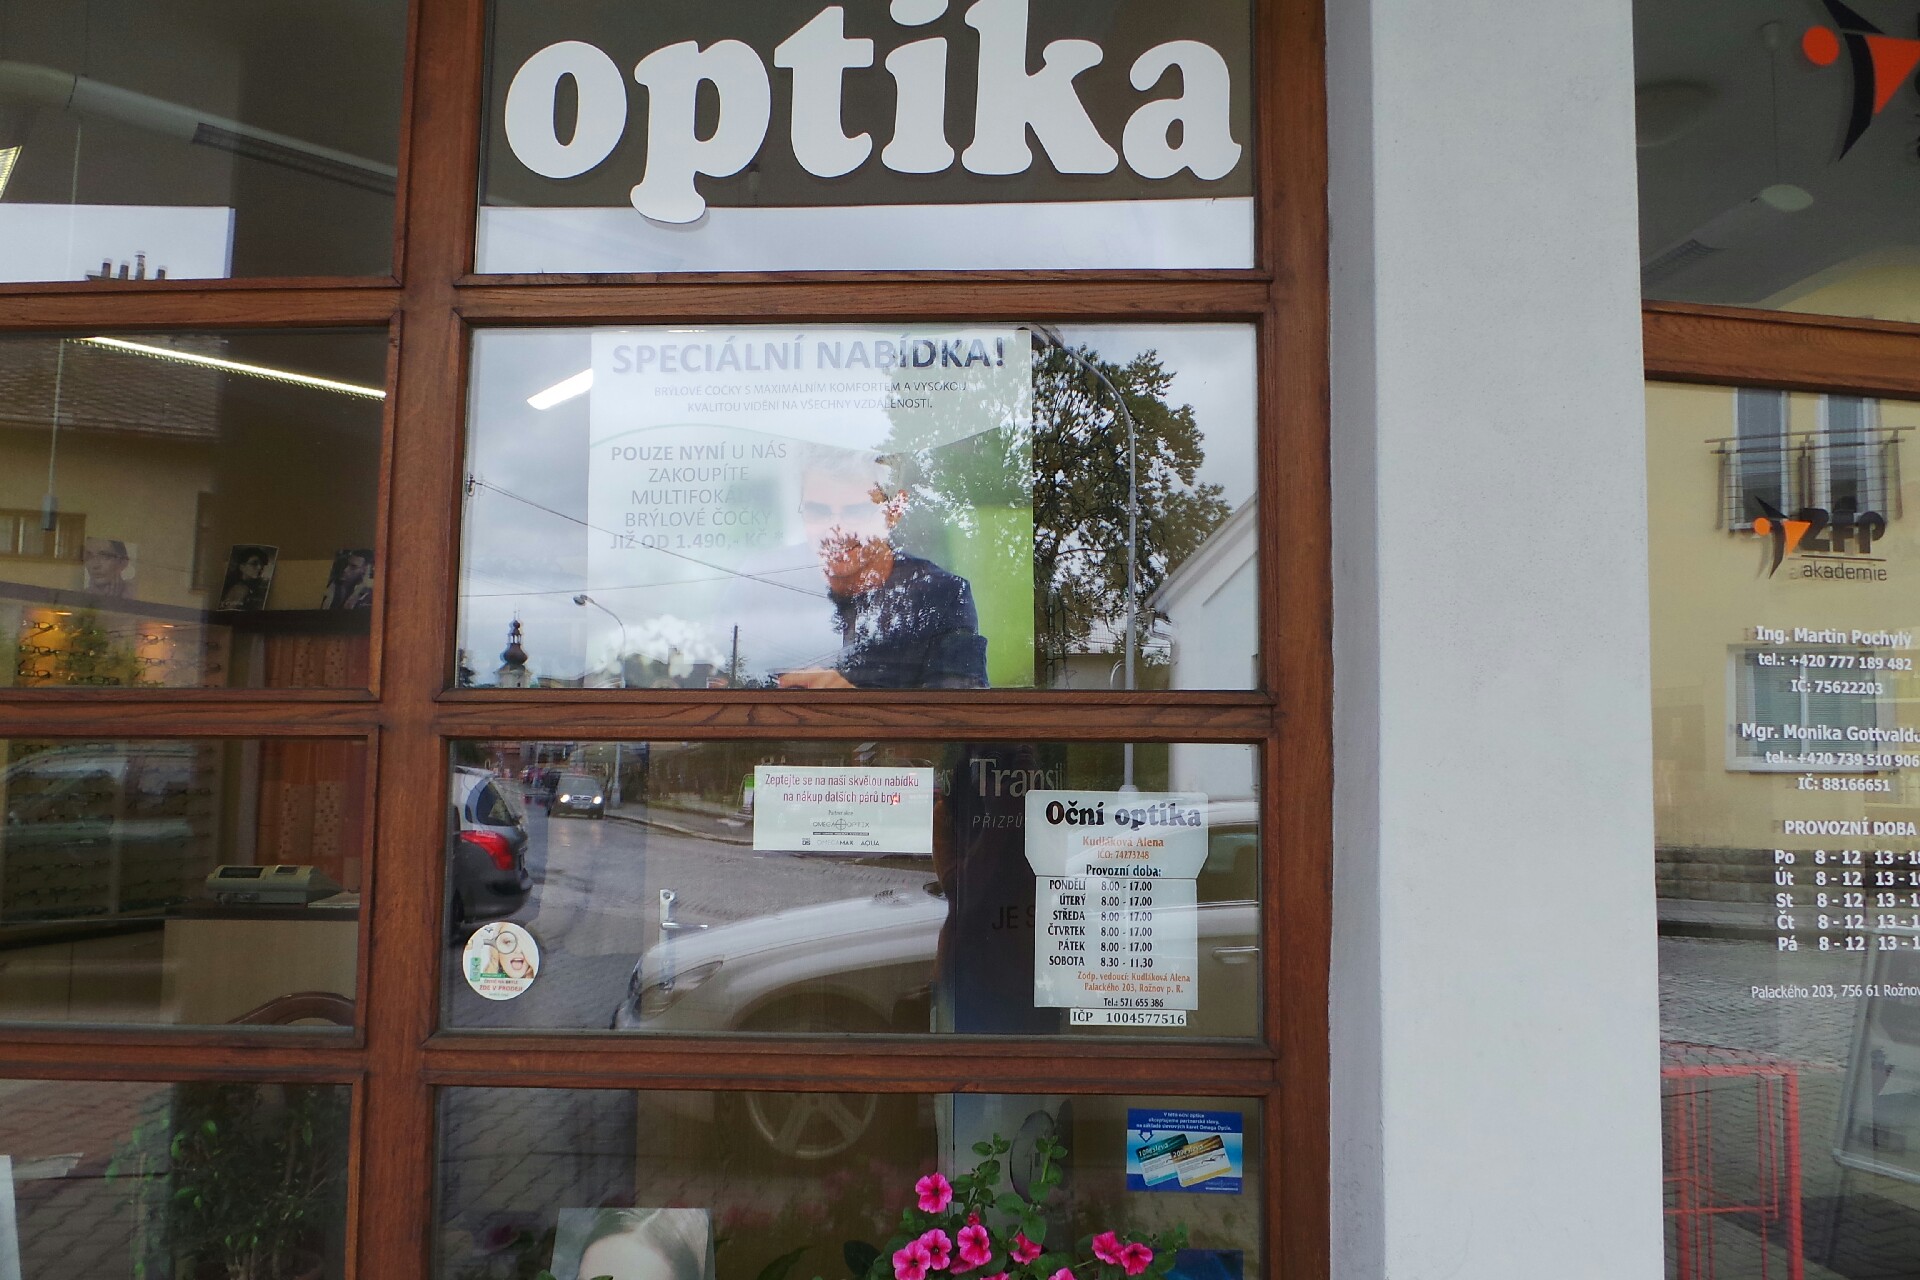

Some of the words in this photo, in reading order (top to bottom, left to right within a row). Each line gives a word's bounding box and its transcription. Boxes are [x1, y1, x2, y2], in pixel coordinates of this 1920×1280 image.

[505, 0, 1242, 223] optika
[612, 336, 804, 374] SPECIÁLNÍ
[817, 334, 1005, 370] NABÍDKA!
[745, 386, 751, 395] S
[830, 382, 900, 393] KOMFORTEM
[904, 382, 911, 391] A
[687, 402, 741, 413] KVALITOU
[782, 401, 798, 411] NA
[800, 397, 851, 410] VŠECHNY
[611, 446, 673, 461] POUZE
[679, 441, 726, 461] NYNÍ
[733, 445, 744, 460] U
[752, 440, 787, 459] NÁS
[648, 463, 749, 483] ZAKOUPÍTE
[625, 508, 705, 528] BRÝLOVÉ
[712, 507, 772, 526] ČOČKY
[610, 530, 636, 549] JIŽ
[642, 534, 670, 549] OD
[1803, 562, 1887, 581] akademie
[1757, 626, 1789, 645] Ing.
[1794, 627, 1846, 644] Martin
[1852, 629, 1911, 649] Pochylý
[1758, 653, 1785, 666] tel.:
[1790, 655, 1825, 668] +420
[1829, 656, 1854, 669] 777
[1859, 656, 1883, 669] 189
[1887, 657, 1911, 670] 482
[1791, 676, 1811, 693] IČ:
[1815, 680, 1883, 695] 75622203
[1742, 723, 1779, 742] Mgr.
[1784, 725, 1842, 741] Monika
[1765, 751, 1793, 764] tel.:
[1797, 753, 1834, 766] +420
[1837, 753, 1862, 766] 739
[1866, 754, 1891, 767] 510
[1895, 754, 1920, 767] 906
[765, 773, 800, 787] Zeptejte
[802, 776, 813, 786] se
[815, 776, 826, 786] na
[828, 774, 846, 786] naší
[848, 774, 882, 787] skvělou
[884, 775, 919, 787] nabídku
[1798, 774, 1818, 791] IČ:
[1823, 777, 1890, 792] 88166651
[783, 792, 794, 802] na
[796, 791, 823, 804] nákup
[825, 791, 857, 803] dalších
[859, 791, 879, 805] párů
[1045, 800, 1105, 826] Oční
[1114, 802, 1202, 832] optika
[1784, 817, 1868, 835] PROVOZNÍ
[1874, 822, 1917, 836] DOBA
[1082, 835, 1133, 847] Kudláková
[1136, 837, 1164, 847] Alena
[1774, 850, 1795, 864] Po
[1815, 850, 1826, 865] 8
[1842, 850, 1862, 865] 12
[1874, 850, 1893, 865] 13
[1086, 864, 1130, 877] Provozní
[1132, 864, 1161, 877] doba:
[1775, 867, 1794, 886] Út
[1815, 871, 1826, 886] 8
[1843, 871, 1863, 886] 12
[1875, 871, 1894, 886] 13
[1049, 878, 1087, 890] PONDĚLÍ
[1101, 881, 1120, 891] 8.00
[1129, 881, 1152, 891] 17.00
[1059, 893, 1086, 906] ÚTERÝ
[1100, 896, 1120, 906] 8.00
[1129, 896, 1152, 906] 17.00
[1776, 893, 1794, 907] St
[1817, 893, 1828, 907] 8
[1843, 893, 1863, 907] 12
[1876, 893, 1895, 907] 13
[1053, 908, 1085, 921] STŘEDA
[1100, 912, 1120, 922] 8.00
[1129, 912, 1152, 922] 17.00
[1777, 910, 1795, 929] Čt
[1818, 915, 1829, 929] 8
[1844, 915, 1864, 929] 12
[1878, 915, 1897, 929] 13
[1048, 923, 1085, 936] ČTVRTEK
[1100, 927, 1120, 937] 8.00
[1129, 927, 1152, 937] 17.00
[1058, 938, 1085, 951] PÁTEK
[1100, 942, 1120, 952] 8.00
[1129, 942, 1152, 952] 17.00
[1778, 935, 1798, 951] Pá
[1819, 936, 1830, 950] 8
[1845, 936, 1865, 950] 12
[1879, 936, 1898, 950] 13
[1049, 956, 1085, 967] SOBOTA
[1100, 957, 1119, 968] 8.30
[1130, 958, 1154, 968] 11.30
[1078, 971, 1098, 982] Zodp.
[1100, 971, 1129, 981] vedoucí:
[1131, 972, 1168, 982] Kudláková
[1170, 973, 1191, 982] Alena
[1084, 983, 1120, 993] Palackého
[1122, 983, 1137, 993] 203,
[1139, 983, 1164, 993] Rožnov
[1166, 986, 1174, 995] p.
[1176, 985, 1184, 993] R.
[1751, 984, 1808, 998] Palackého
[1812, 985, 1837, 999] 203,
[1841, 985, 1862, 997] 756
[1866, 984, 1880, 997] 61
[1104, 997, 1118, 1007] Tel.:
[1120, 998, 1133, 1007] 571
[1135, 998, 1149, 1007] 655
[1151, 998, 1164, 1007] 386
[1073, 1009, 1093, 1022] IČP
[1106, 1012, 1185, 1025] 1004577516
